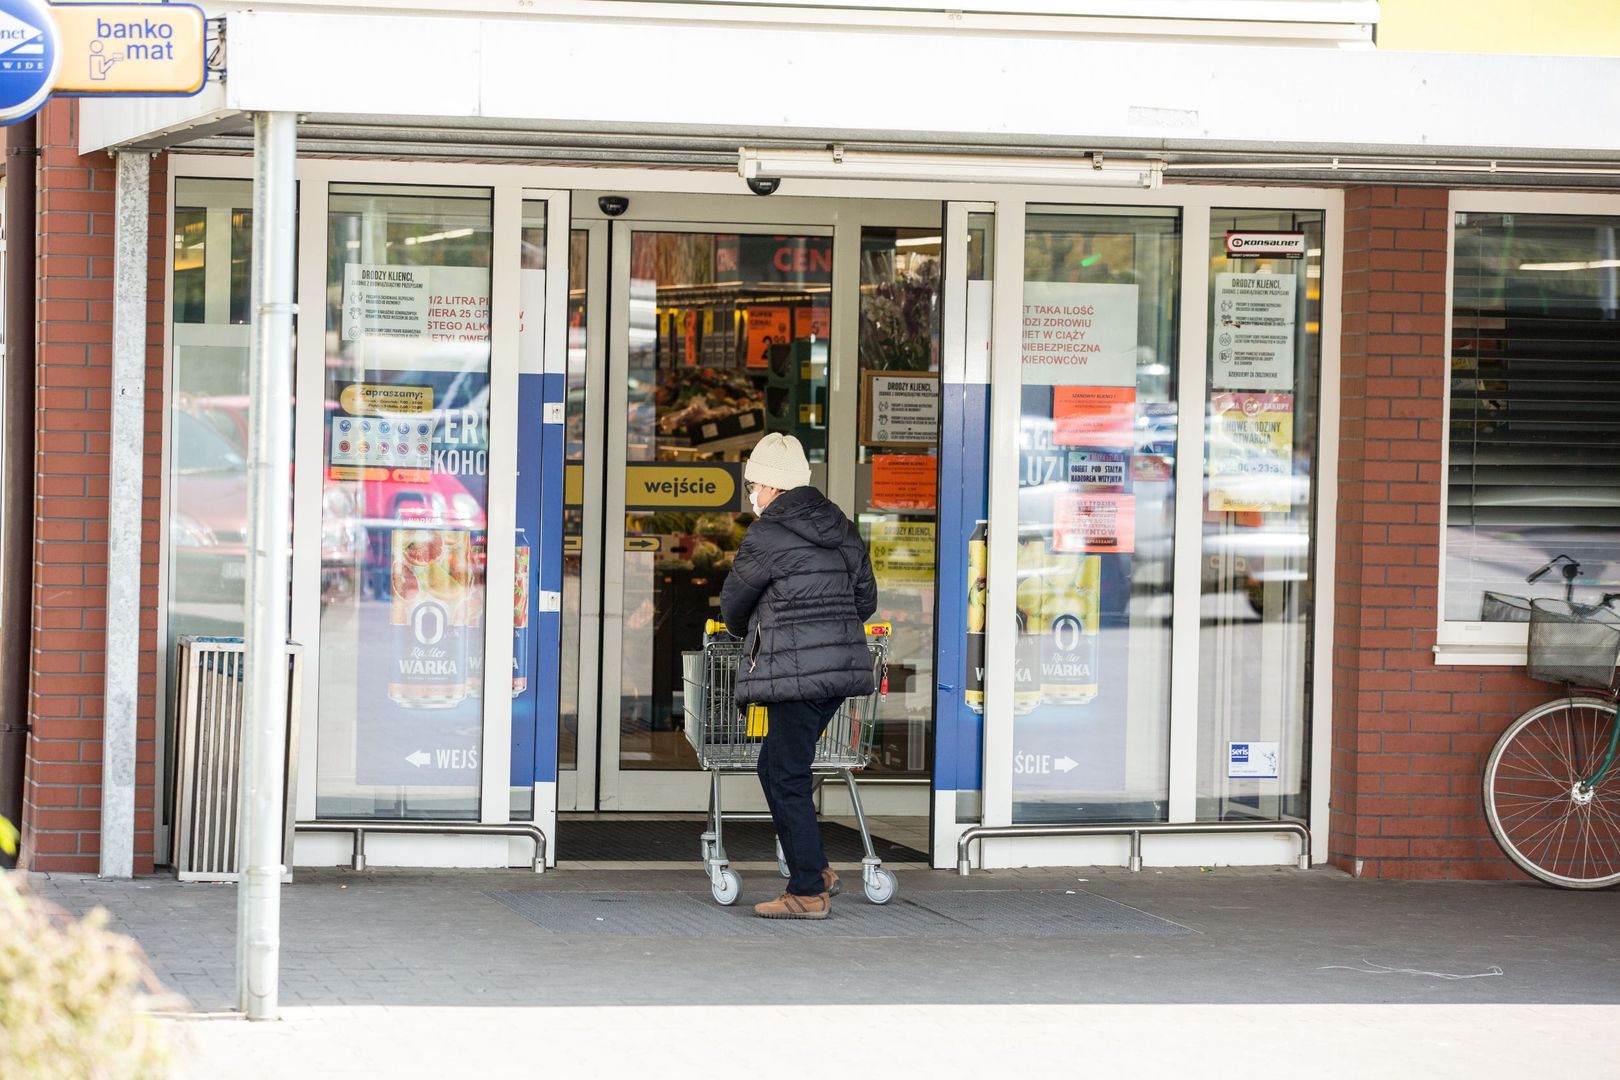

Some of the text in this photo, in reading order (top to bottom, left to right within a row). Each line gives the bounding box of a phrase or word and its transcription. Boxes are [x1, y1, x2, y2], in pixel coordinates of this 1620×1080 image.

[0, 28, 25, 40] net
[97, 18, 173, 39] banko
[127, 41, 173, 60] mat
[362, 269, 387, 280] DRODZY
[1232, 278, 1281, 289] DRODZY KLIENCI,
[428, 295, 443, 305] 1/2
[445, 296, 477, 305] LITRA
[459, 309, 471, 318] 25
[1034, 305, 1061, 314] TAKA
[1063, 304, 1095, 315] ILOŚĆ
[1043, 318, 1092, 328] ZDROWIU
[1043, 330, 1053, 339] W
[1055, 329, 1086, 341] CIĄŻY
[1021, 343, 1101, 352] NIEBEZPIECZNA
[1021, 354, 1088, 365] KIEROWCÓW
[1248, 421, 1281, 433] ODZINY
[1091, 465, 1102, 473] POD
[644, 477, 717, 498] wejście
[415, 605, 444, 645] 0
[1055, 618, 1079, 652] 0
[399, 659, 458, 675] WARKA
[1042, 663, 1090, 677] WARKA
[436, 745, 478, 769] WEJŚ
[1014, 750, 1051, 774] ŚCIE
